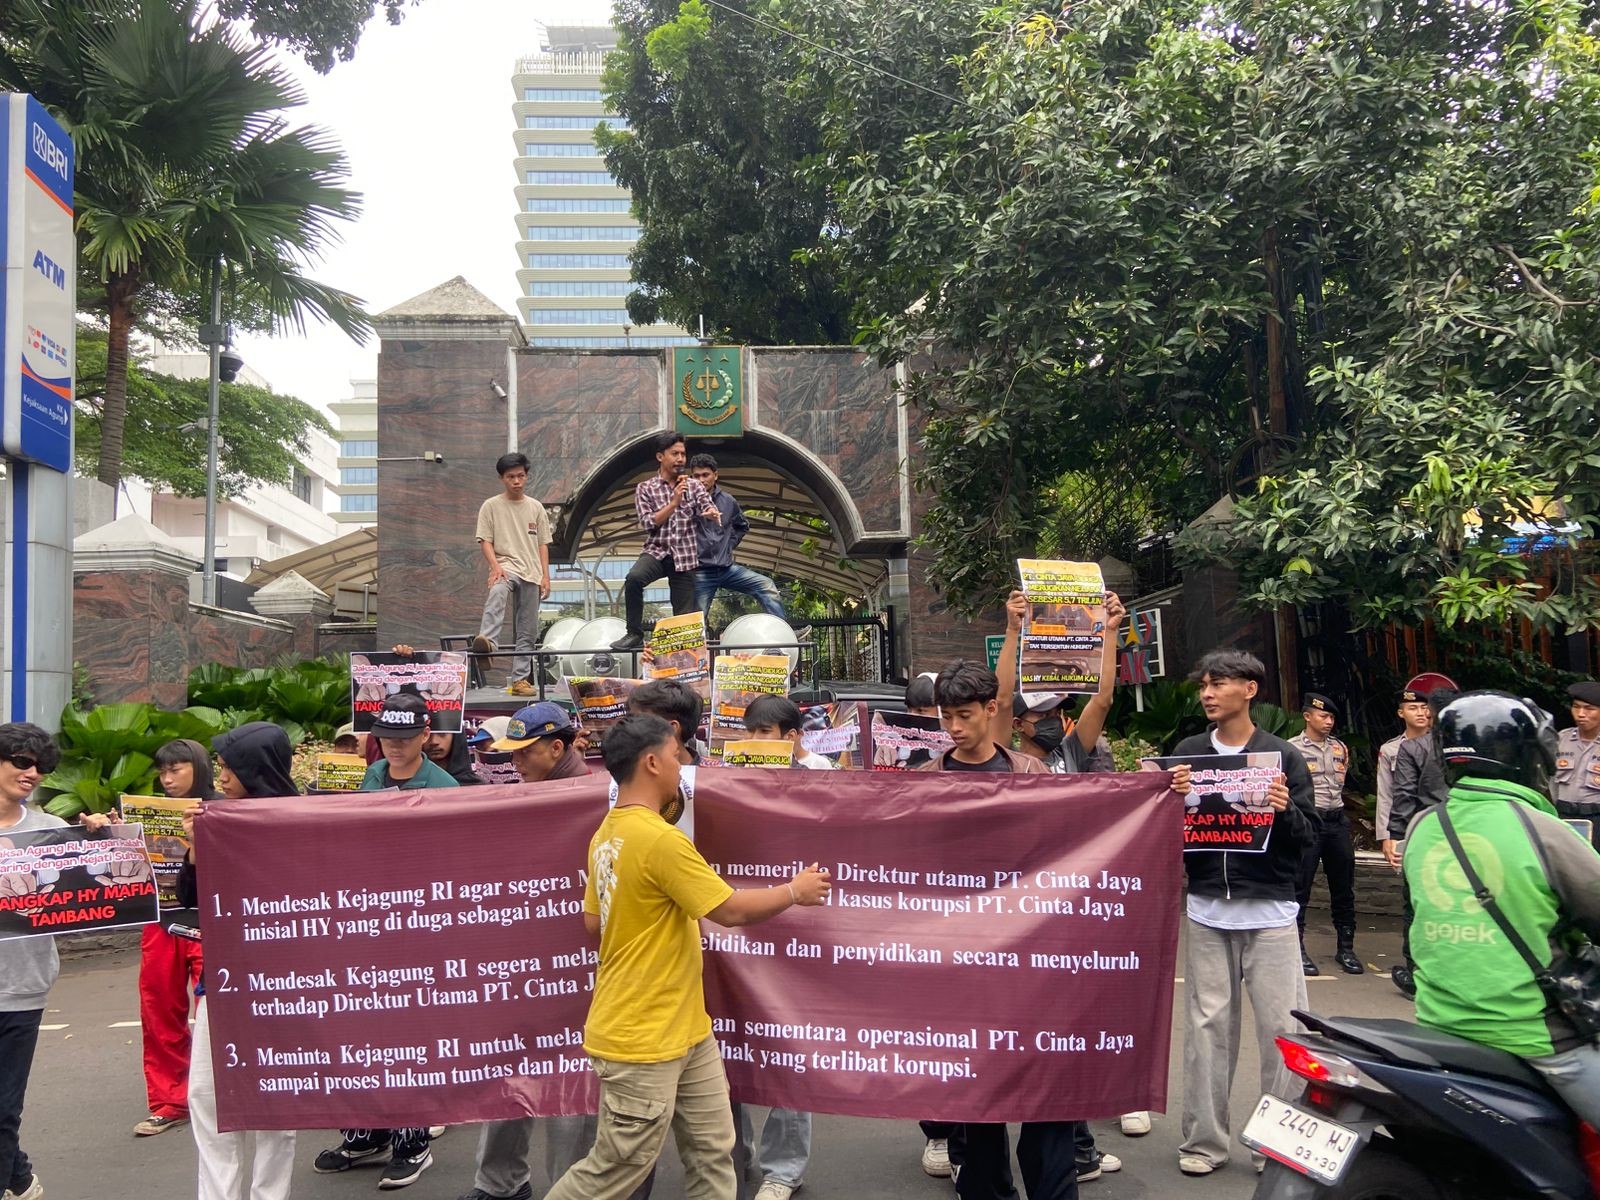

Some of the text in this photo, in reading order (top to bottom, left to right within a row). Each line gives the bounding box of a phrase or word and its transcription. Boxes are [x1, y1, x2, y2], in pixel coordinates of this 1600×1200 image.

[47, 138, 68, 182] BRI
[33, 249, 65, 291] ATM
[23, 393, 65, 426] Kejaksaan Agung
[1028, 595, 1063, 604] SEBESAR
[357, 676, 383, 685] Taring
[385, 676, 412, 685] dengan
[435, 675, 461, 683] Sultra
[379, 664, 405, 674] Agung
[426, 700, 462, 711] MAFIA
[765, 757, 790, 765] DIDUG
[1253, 768, 1281, 777] kalah
[1216, 783, 1244, 793] Kejati
[1218, 814, 1237, 825] HY
[26, 844, 64, 856] Agung
[1183, 830, 1253, 844] TAMBANG
[0, 851, 144, 873] aring dengan Kejati Sultra
[836, 862, 920, 885] Direktur
[926, 870, 987, 889] utama
[993, 871, 1029, 889] PT.
[1035, 871, 1090, 889] Cinta
[1097, 870, 1142, 895] Jaya
[0, 882, 156, 911] ANGKAP HY MAFIA
[212, 893, 232, 918] 1.
[241, 891, 332, 917] Mendesak
[337, 886, 426, 912] Kejagung
[431, 880, 454, 901] RI
[459, 881, 503, 903] agar
[508, 875, 572, 897] segera
[839, 888, 893, 910] kasus
[897, 891, 971, 917] korupsi
[977, 895, 1013, 914] PT.
[1018, 895, 1074, 915] Cinta
[1079, 896, 1125, 921] Jaya
[29, 905, 116, 927] TAMBANG
[243, 919, 298, 942] inisial
[302, 916, 331, 938] HY
[336, 917, 381, 940] yang
[384, 911, 402, 931] di
[407, 909, 453, 932] duga
[457, 900, 531, 927] sebagai
[1423, 920, 1498, 946] gojek
[217, 946, 599, 993] 2. Mendesak Kejagung RI segera mela
[700, 932, 1140, 974] elidikan dan penyidikan secara menyeluruh
[252, 995, 329, 1019] terhadap
[333, 990, 412, 1013] Direktur
[416, 986, 479, 1008] Utama
[483, 980, 519, 1003] PT.
[523, 977, 579, 999] Cinta
[225, 1026, 584, 1069] 3. Meminta Kejagung RI untuk mela
[744, 1018, 847, 1043] sementara
[857, 1025, 977, 1050] operasional
[988, 1029, 1025, 1051] PT.
[1035, 1030, 1087, 1052] Cinta
[1095, 1030, 1135, 1055] Jaya
[259, 1053, 594, 1096] sampai proses hukum tuntas dan bers
[718, 1039, 978, 1083] hak yang terlibat korupsi.
[1257, 1099, 1352, 1153] R 2440 MJ
